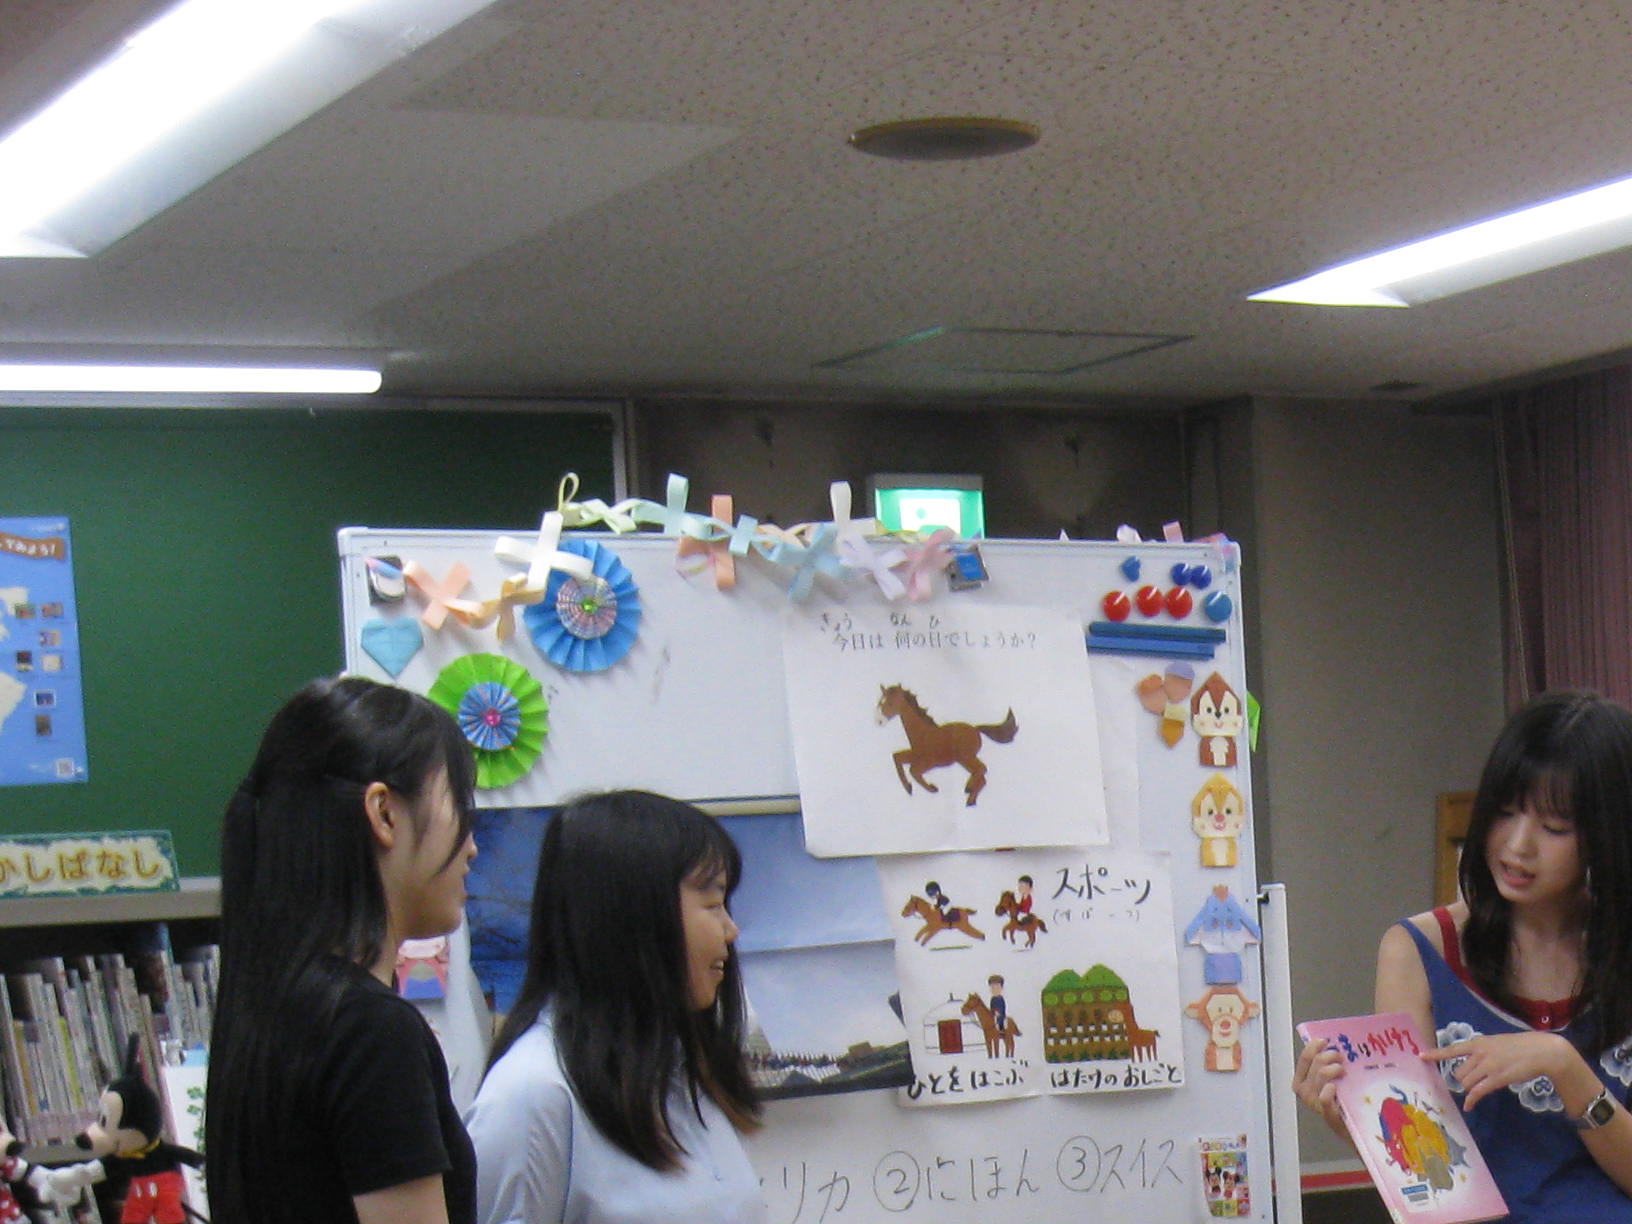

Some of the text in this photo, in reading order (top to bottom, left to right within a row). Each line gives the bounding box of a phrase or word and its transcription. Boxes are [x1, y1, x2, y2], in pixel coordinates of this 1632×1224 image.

[1051, 863, 1153, 905] スポーツ
[906, 1058, 1030, 1100] ひとを はこぶ
[1050, 1061, 1183, 1089] はたけの おしごと
